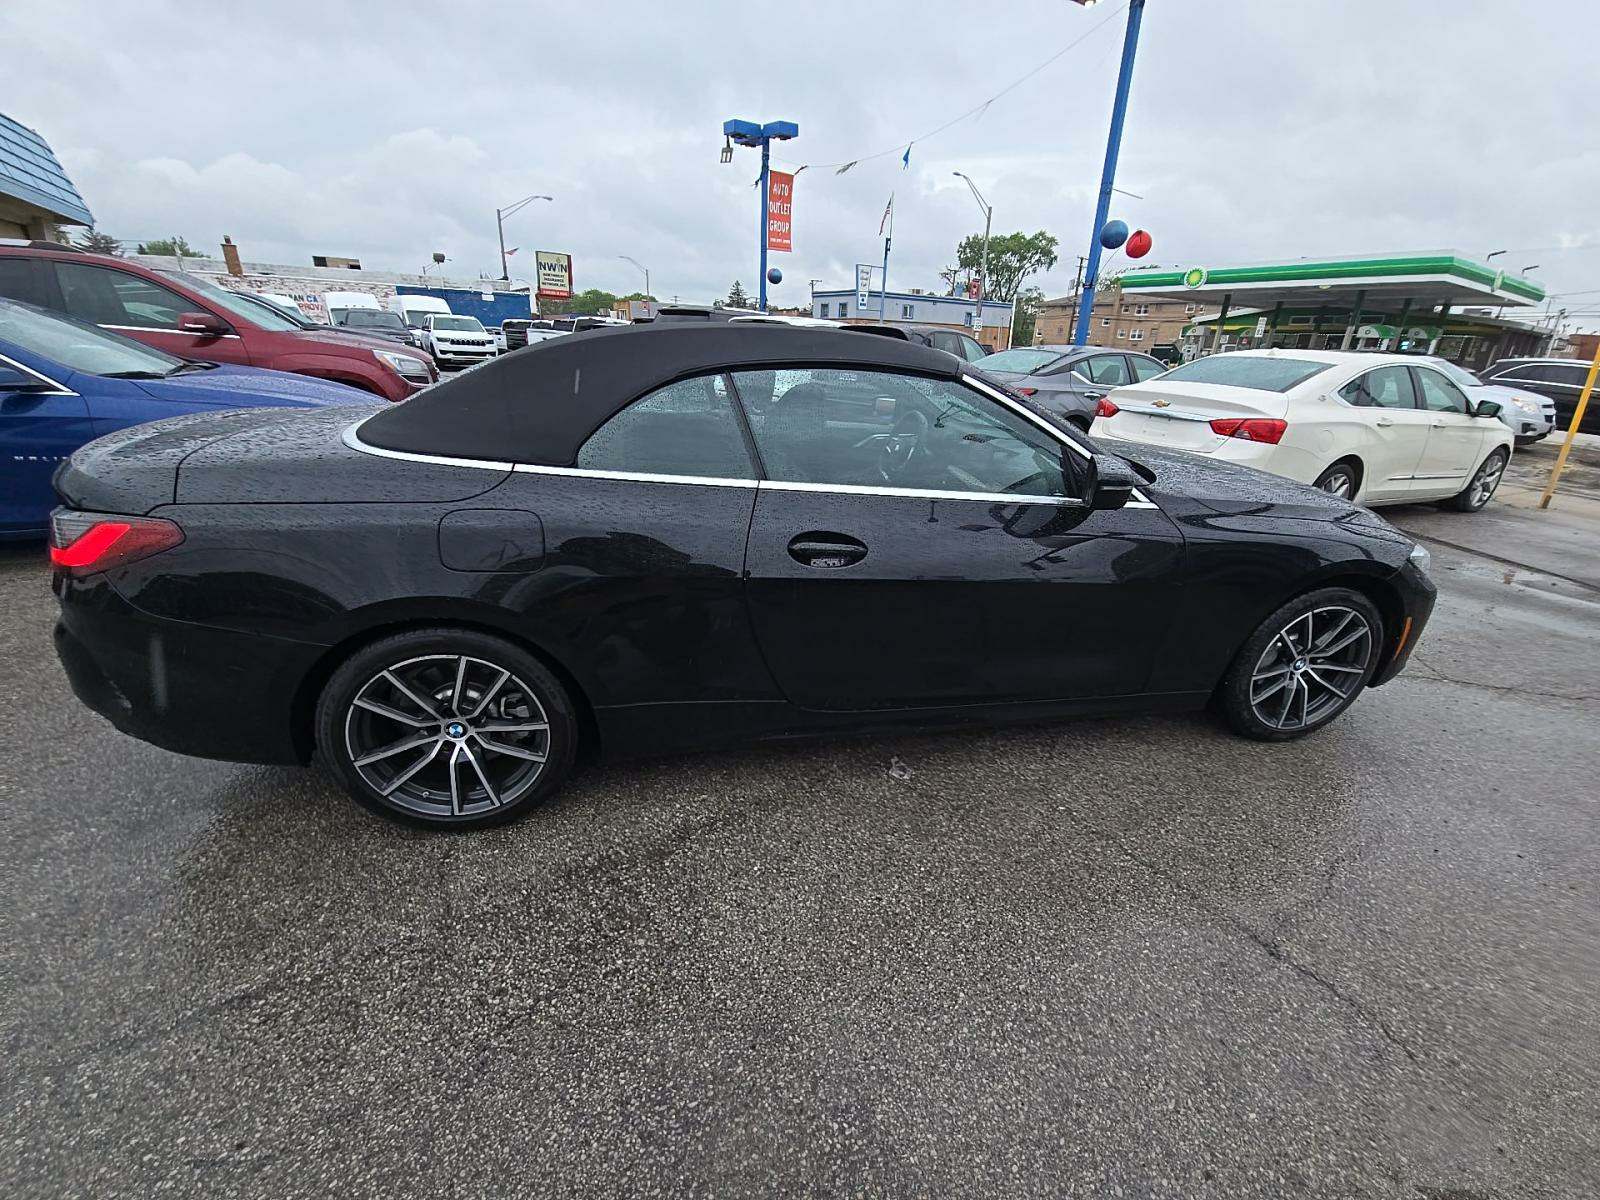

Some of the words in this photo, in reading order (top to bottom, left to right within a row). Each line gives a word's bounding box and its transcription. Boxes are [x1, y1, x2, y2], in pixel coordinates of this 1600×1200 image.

[773, 183, 789, 196] AUTO
[769, 201, 791, 215] OUTLET
[769, 220, 790, 233] GROUP
